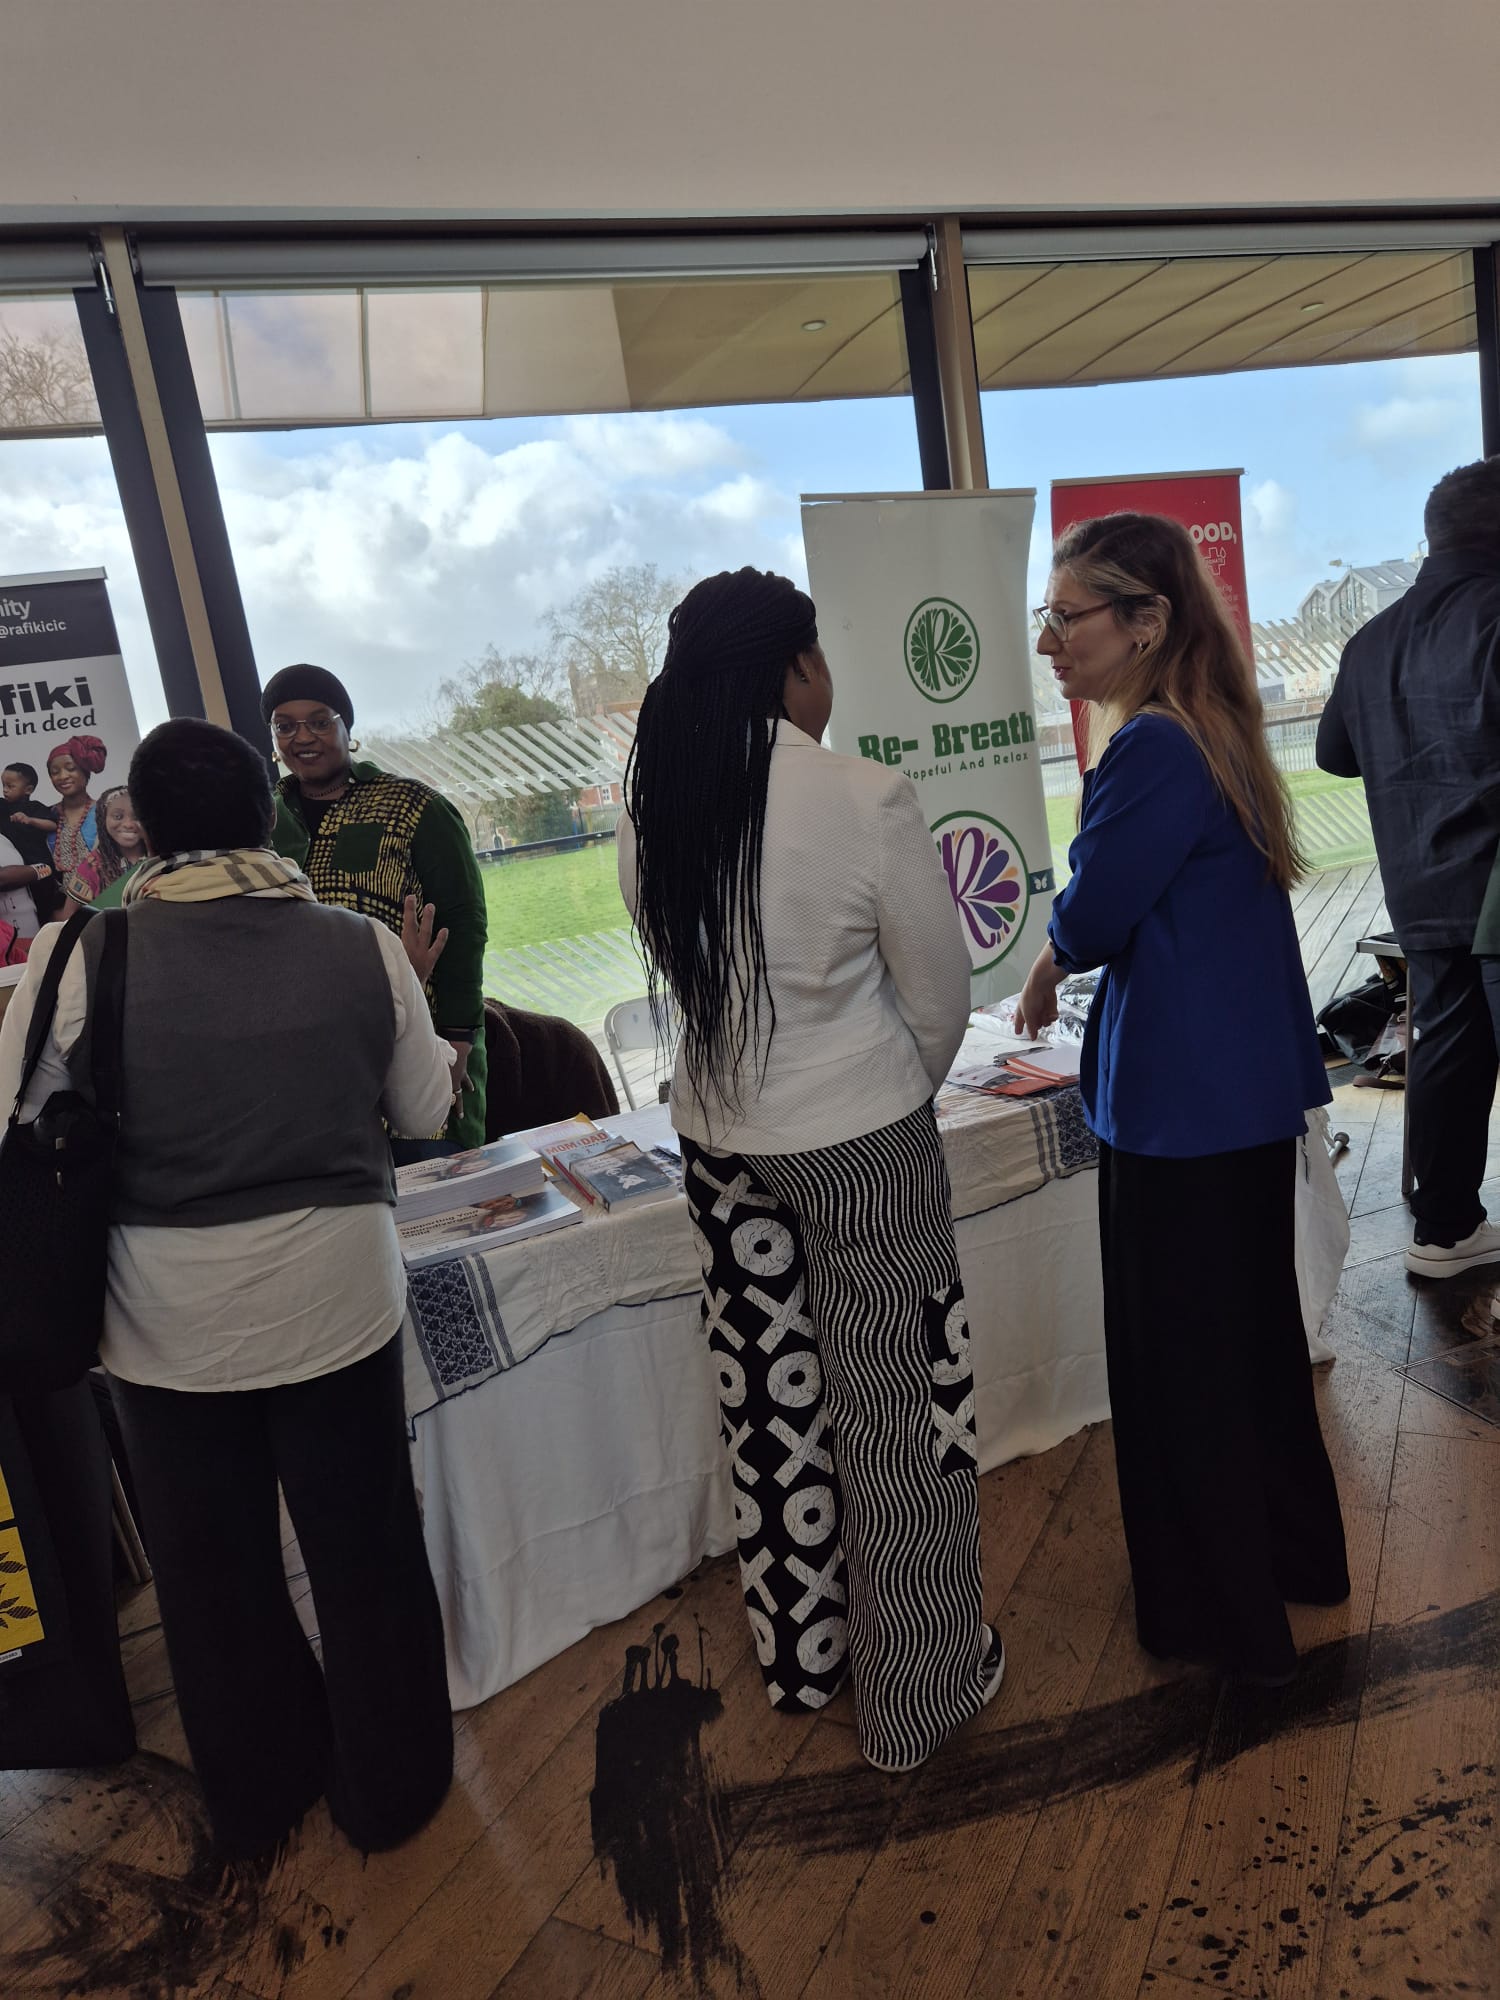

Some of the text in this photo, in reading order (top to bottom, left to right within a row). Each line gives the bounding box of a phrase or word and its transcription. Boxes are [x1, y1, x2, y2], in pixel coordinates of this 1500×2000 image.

[15, 719, 37, 736] in
[42, 707, 97, 732] deed
[858, 711, 1036, 766] Re- Breath
[959, 757, 985, 771] And
[994, 752, 1029, 766] Relax
[546, 1141, 577, 1155] MOM
[581, 1132, 608, 1146] DAD
[400, 1216, 455, 1232] Supporting
[403, 1230, 430, 1239] Child
